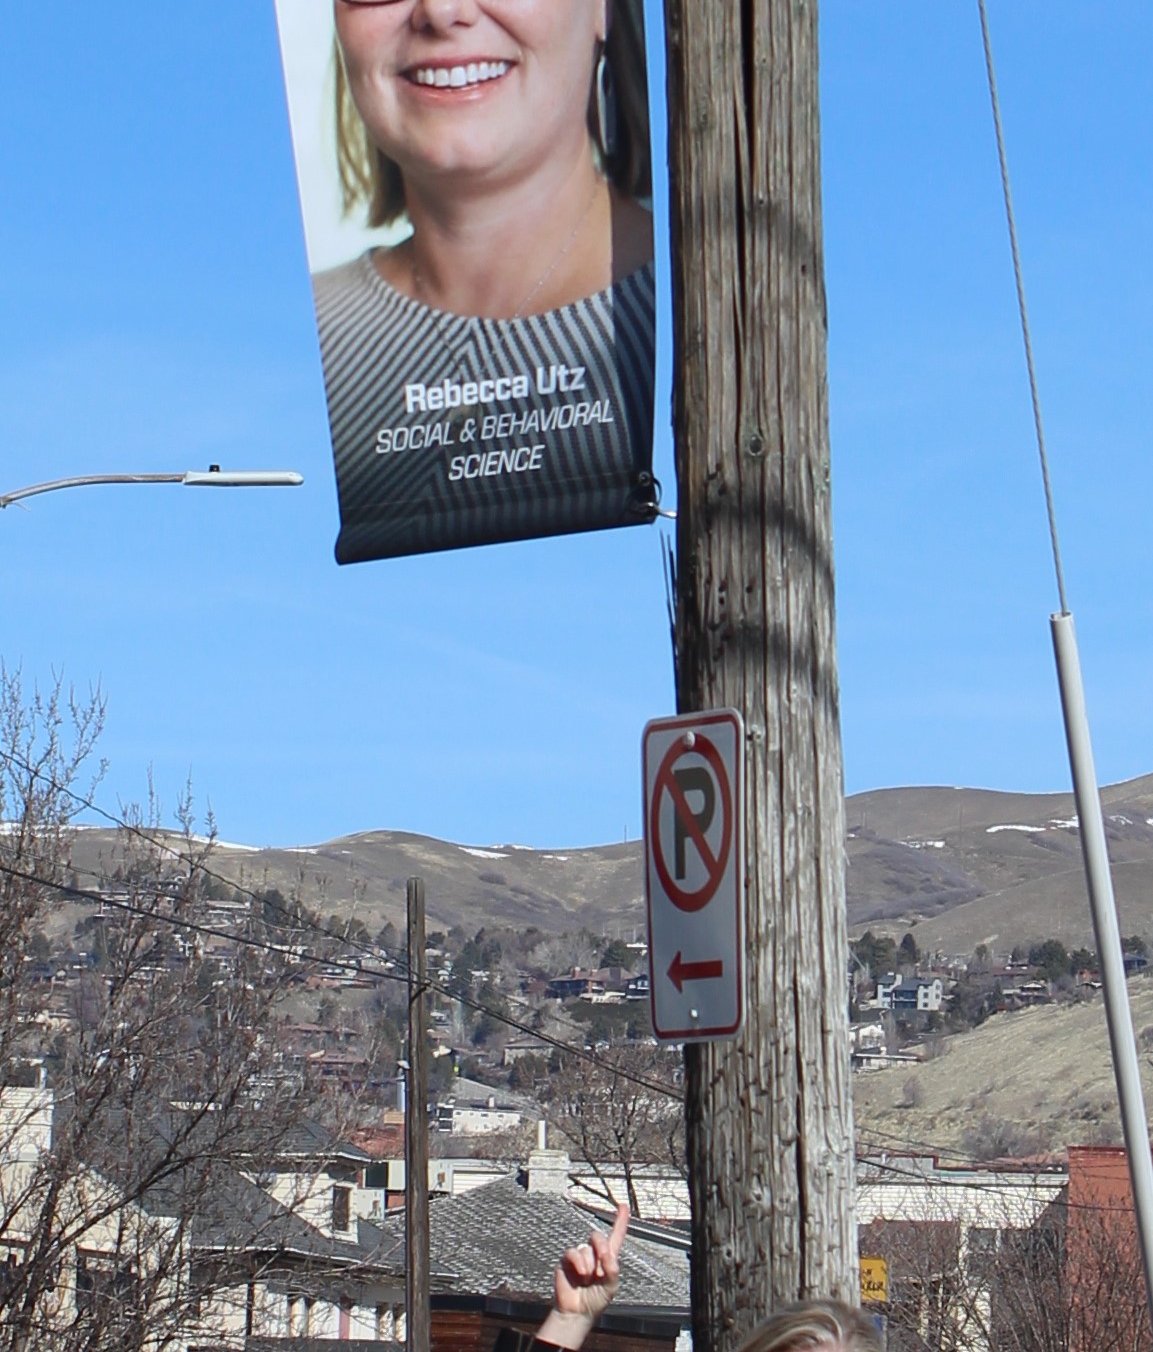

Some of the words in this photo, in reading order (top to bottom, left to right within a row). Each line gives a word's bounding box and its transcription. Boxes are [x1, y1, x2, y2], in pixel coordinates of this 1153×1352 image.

[404, 376, 529, 414] Rebecca
[536, 365, 586, 395] Utz
[375, 421, 454, 454] SOCIAL
[459, 419, 475, 443] &
[480, 399, 614, 440] BEHAVIORAL
[448, 445, 545, 481] SCIENCE
[674, 766, 716, 881] P
